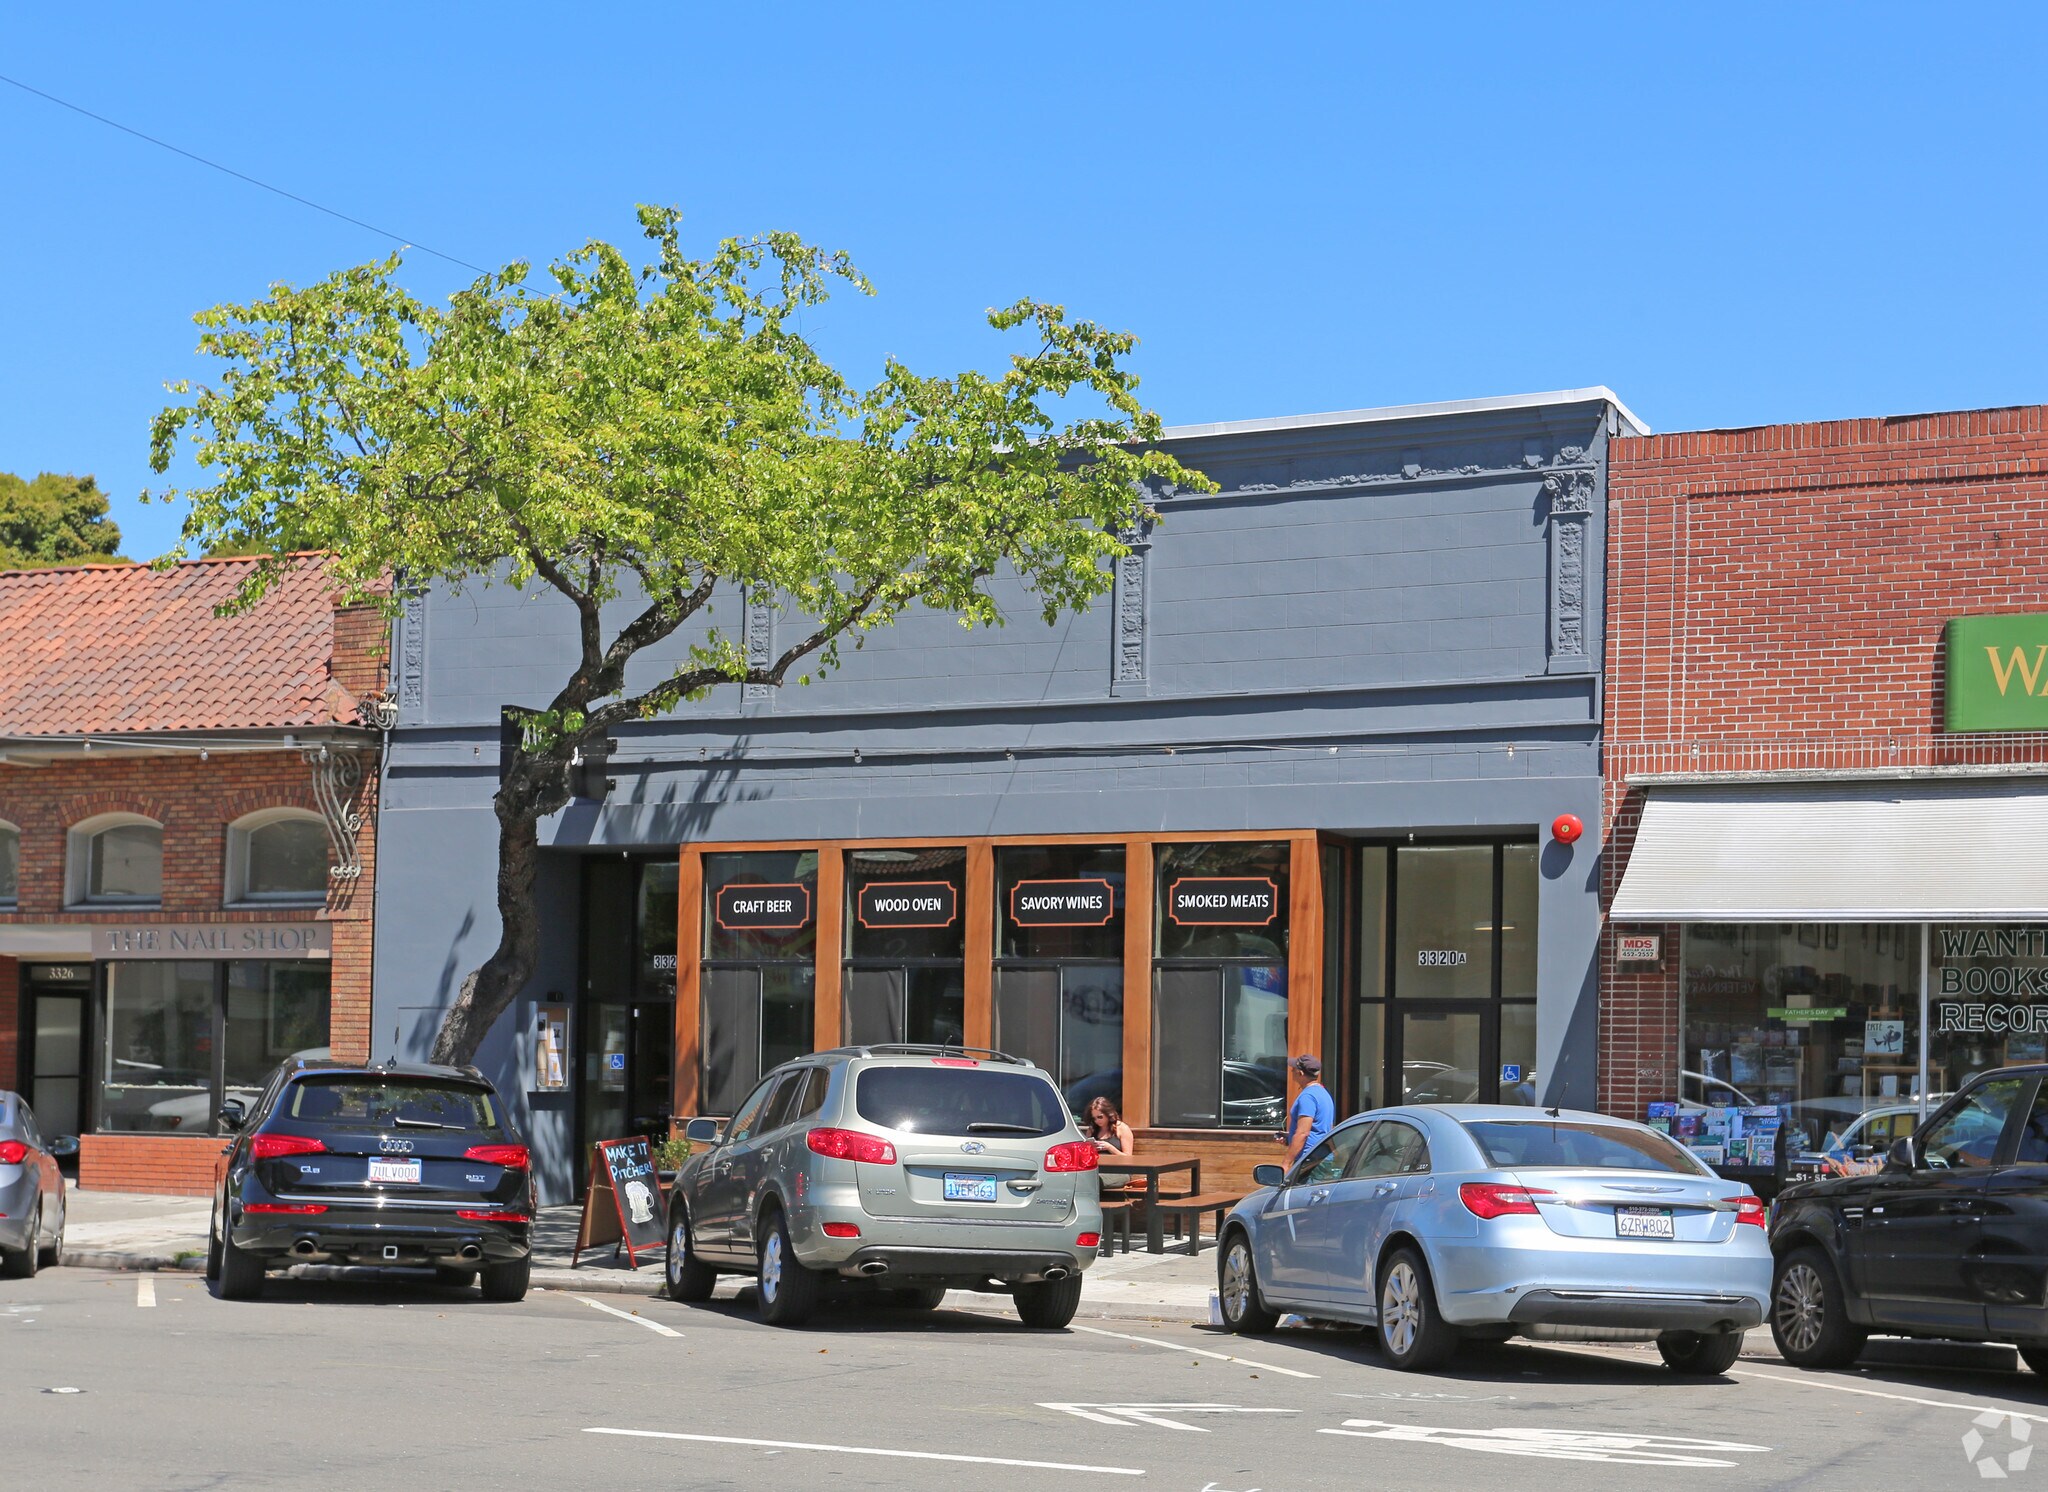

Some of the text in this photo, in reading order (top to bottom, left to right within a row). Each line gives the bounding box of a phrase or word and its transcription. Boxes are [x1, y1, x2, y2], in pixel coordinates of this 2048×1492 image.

[1983, 644, 2048, 697] W
[733, 900, 792, 913] CRAFT BEER
[874, 898, 942, 913] WOOD OVEN
[1021, 896, 1103, 910] SAVORY WINES
[1177, 894, 1269, 908] SMOKED MEATS
[106, 928, 316, 951] THE NAIL SHOP
[1624, 940, 1652, 949] MDS
[49, 967, 74, 980] 3326
[605, 1142, 648, 1162] MAKE IT
[626, 1157, 636, 1166] A
[1620, 1217, 1670, 1234] 6ZRW802
